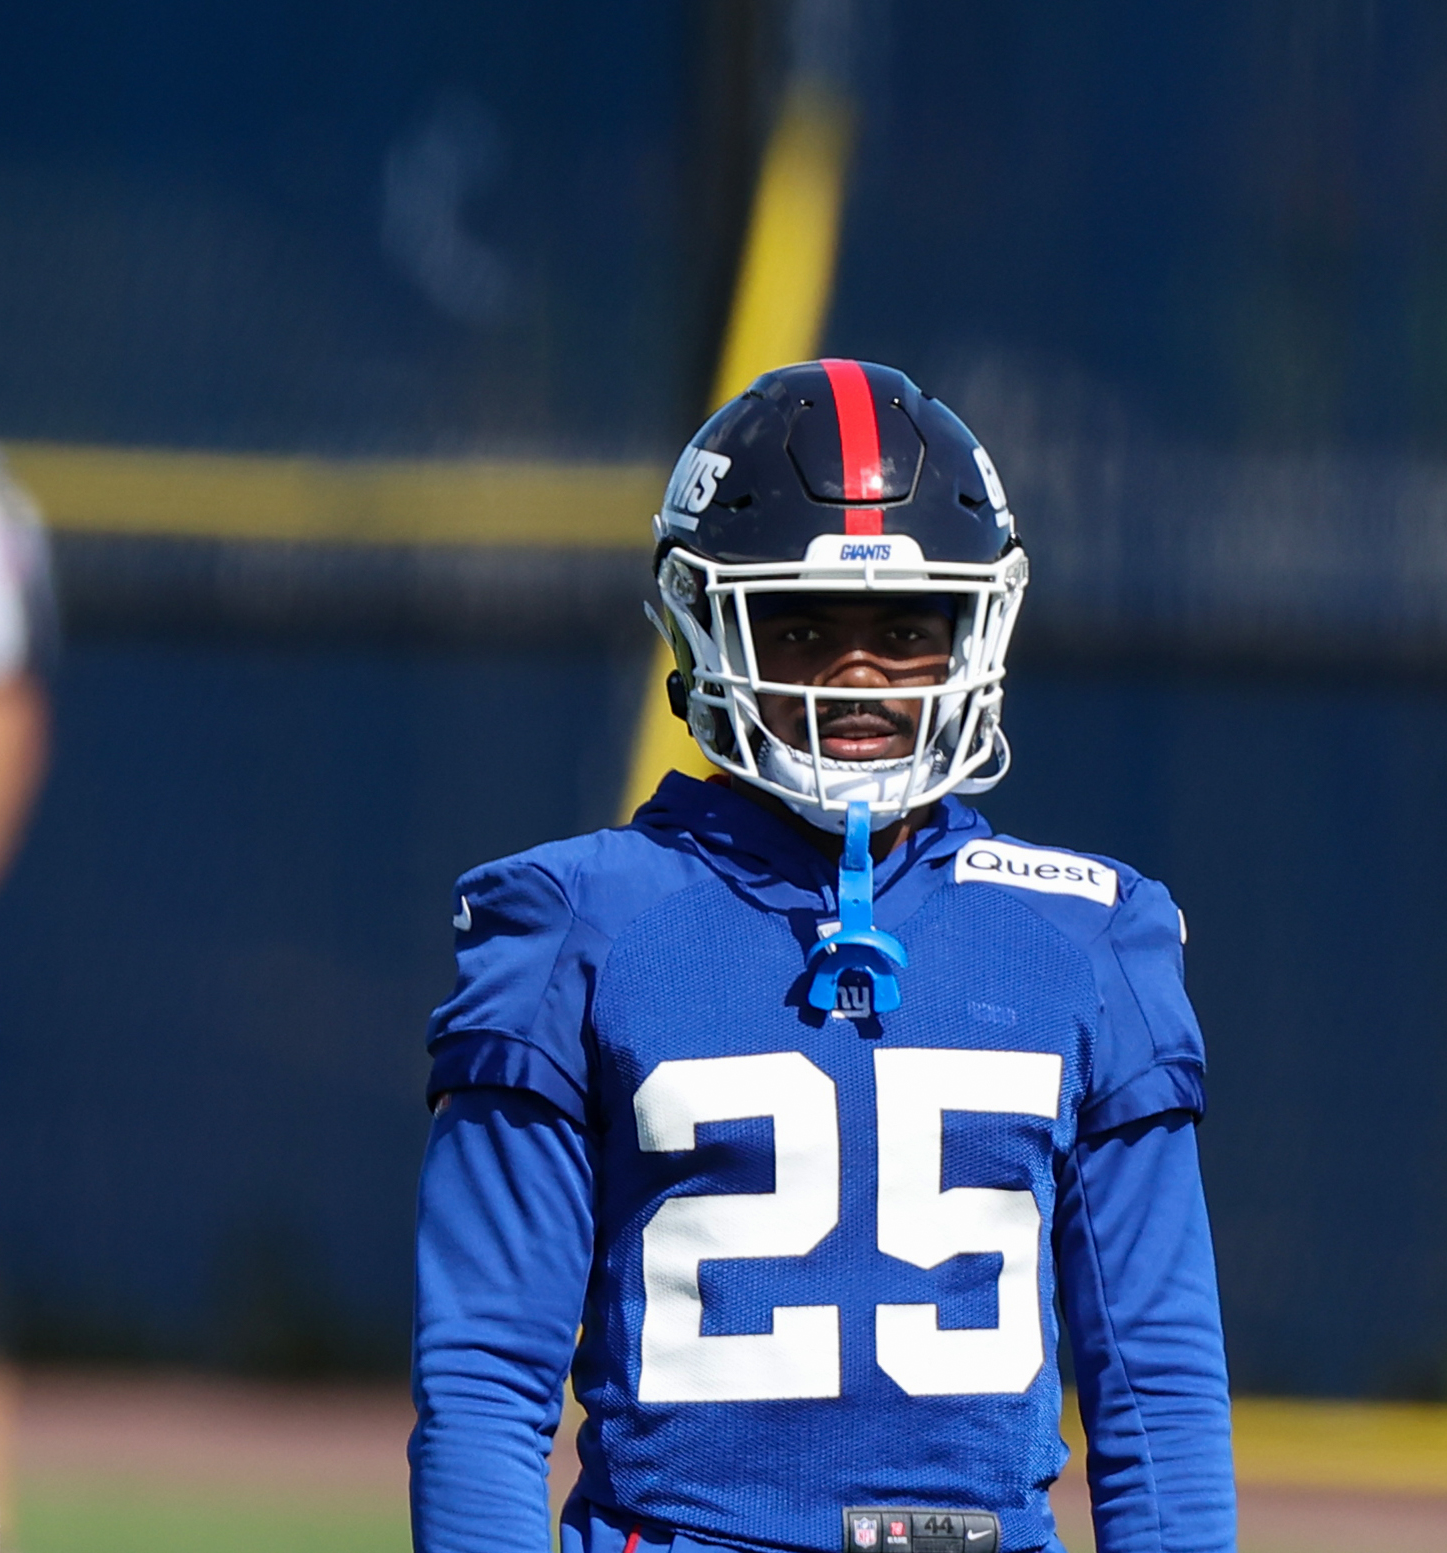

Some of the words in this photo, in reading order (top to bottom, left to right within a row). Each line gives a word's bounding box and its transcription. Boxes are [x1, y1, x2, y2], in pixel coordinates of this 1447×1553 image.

[840, 544, 892, 561] GIANTS
[965, 849, 1102, 887] Quest
[633, 1047, 1063, 1403] 25
[923, 1516, 955, 1535] 44
